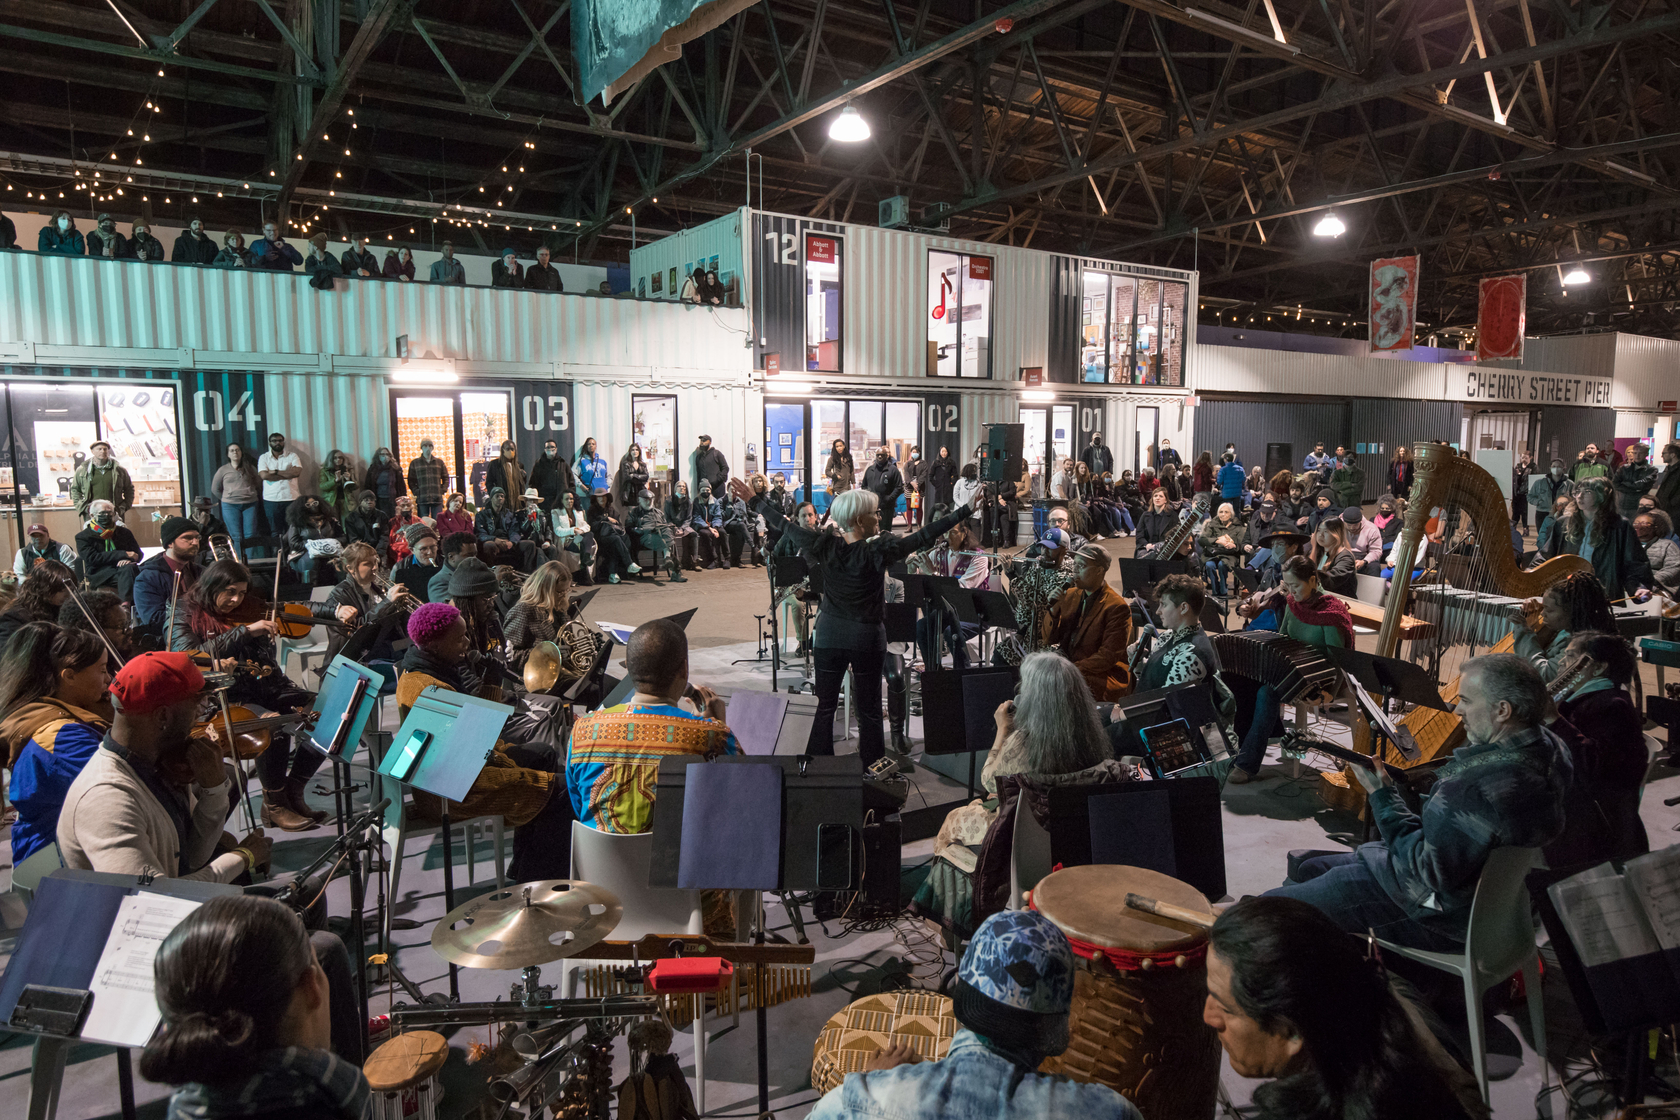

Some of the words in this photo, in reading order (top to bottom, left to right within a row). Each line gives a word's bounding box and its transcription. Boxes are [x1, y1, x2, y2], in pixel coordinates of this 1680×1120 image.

[766, 232, 798, 265] 12
[1466, 372, 1525, 400] CHERRY
[1530, 376, 1581, 402] STREET
[1584, 380, 1610, 404] PIER
[194, 390, 262, 431] 04
[522, 396, 568, 431] 03
[928, 404, 958, 432] 02
[1082, 408, 1102, 432] 01
